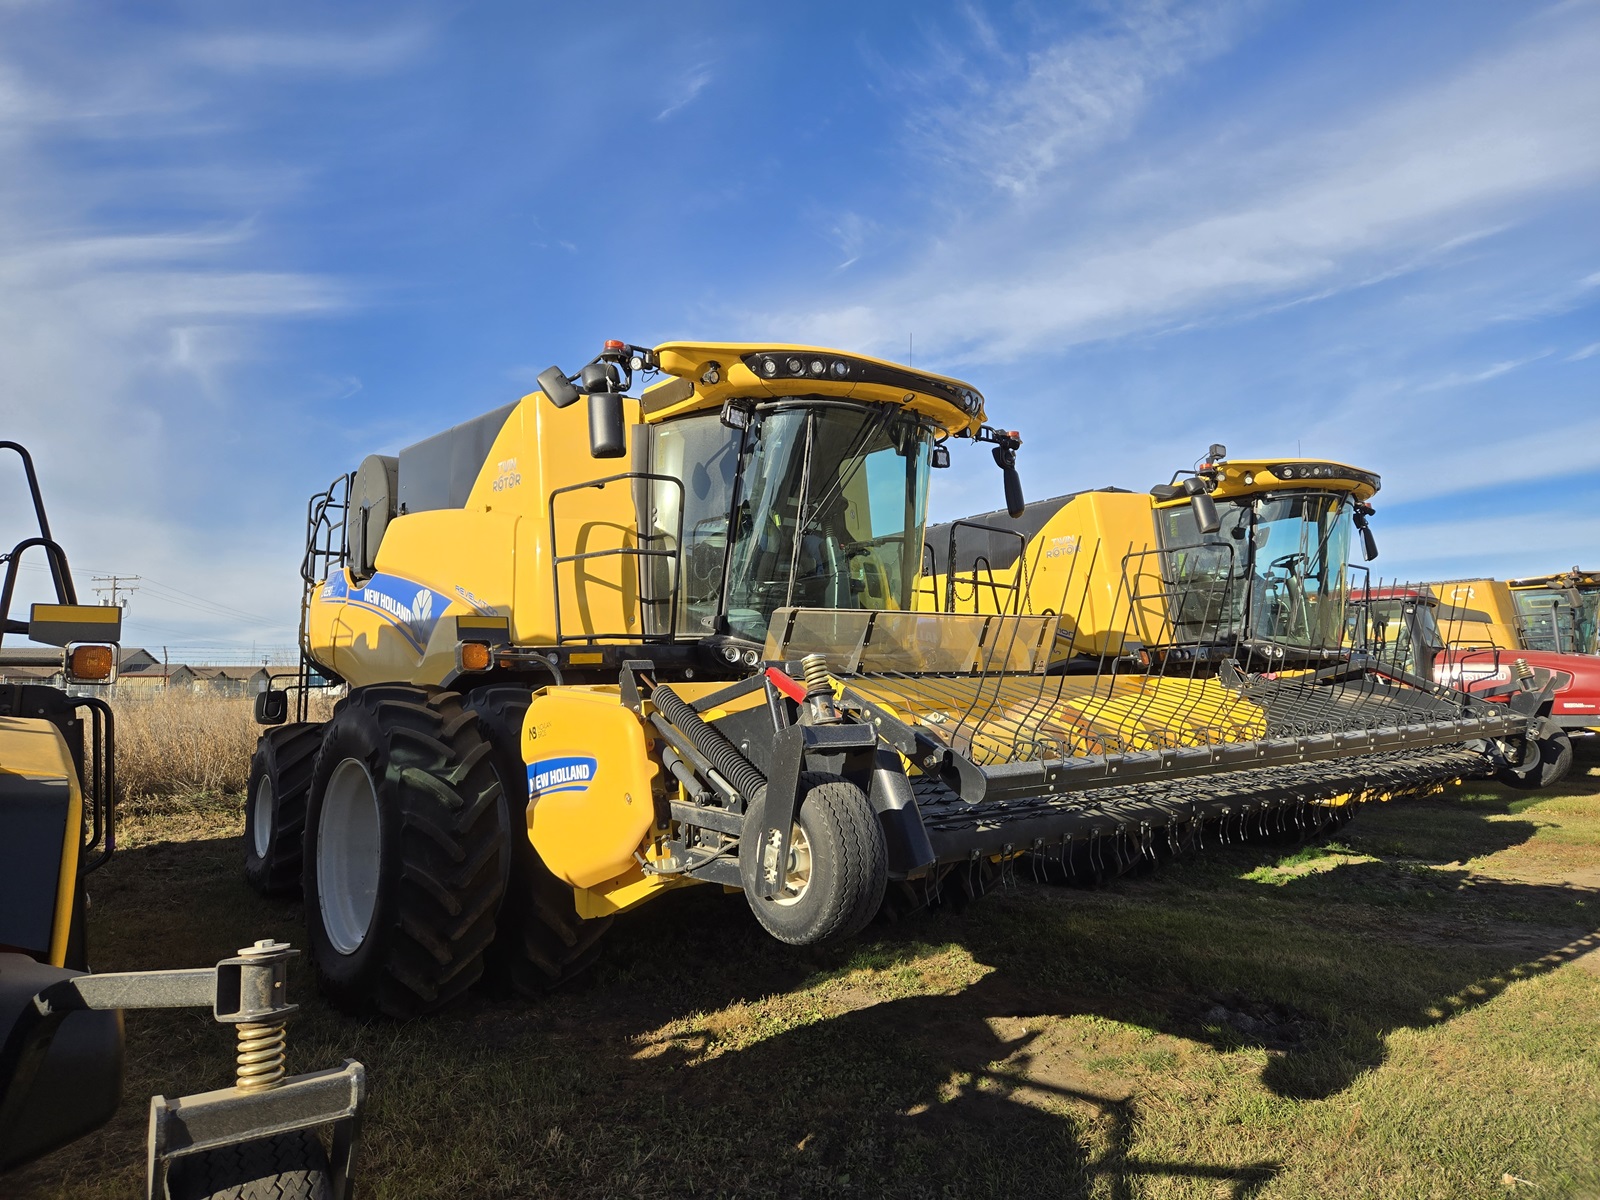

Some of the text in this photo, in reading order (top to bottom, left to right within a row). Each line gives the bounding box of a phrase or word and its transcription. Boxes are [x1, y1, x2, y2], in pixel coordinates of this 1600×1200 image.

[498, 457, 517, 473] TWIN
[493, 472, 521, 492] ROTOR
[1051, 534, 1075, 546] TWIN
[1450, 587, 1475, 601] CR
[364, 588, 380, 606] NEW
[380, 592, 411, 626] HOLLAND
[1459, 672, 1507, 681] ESTWARD
[529, 764, 590, 793] NEW HOLLAND
